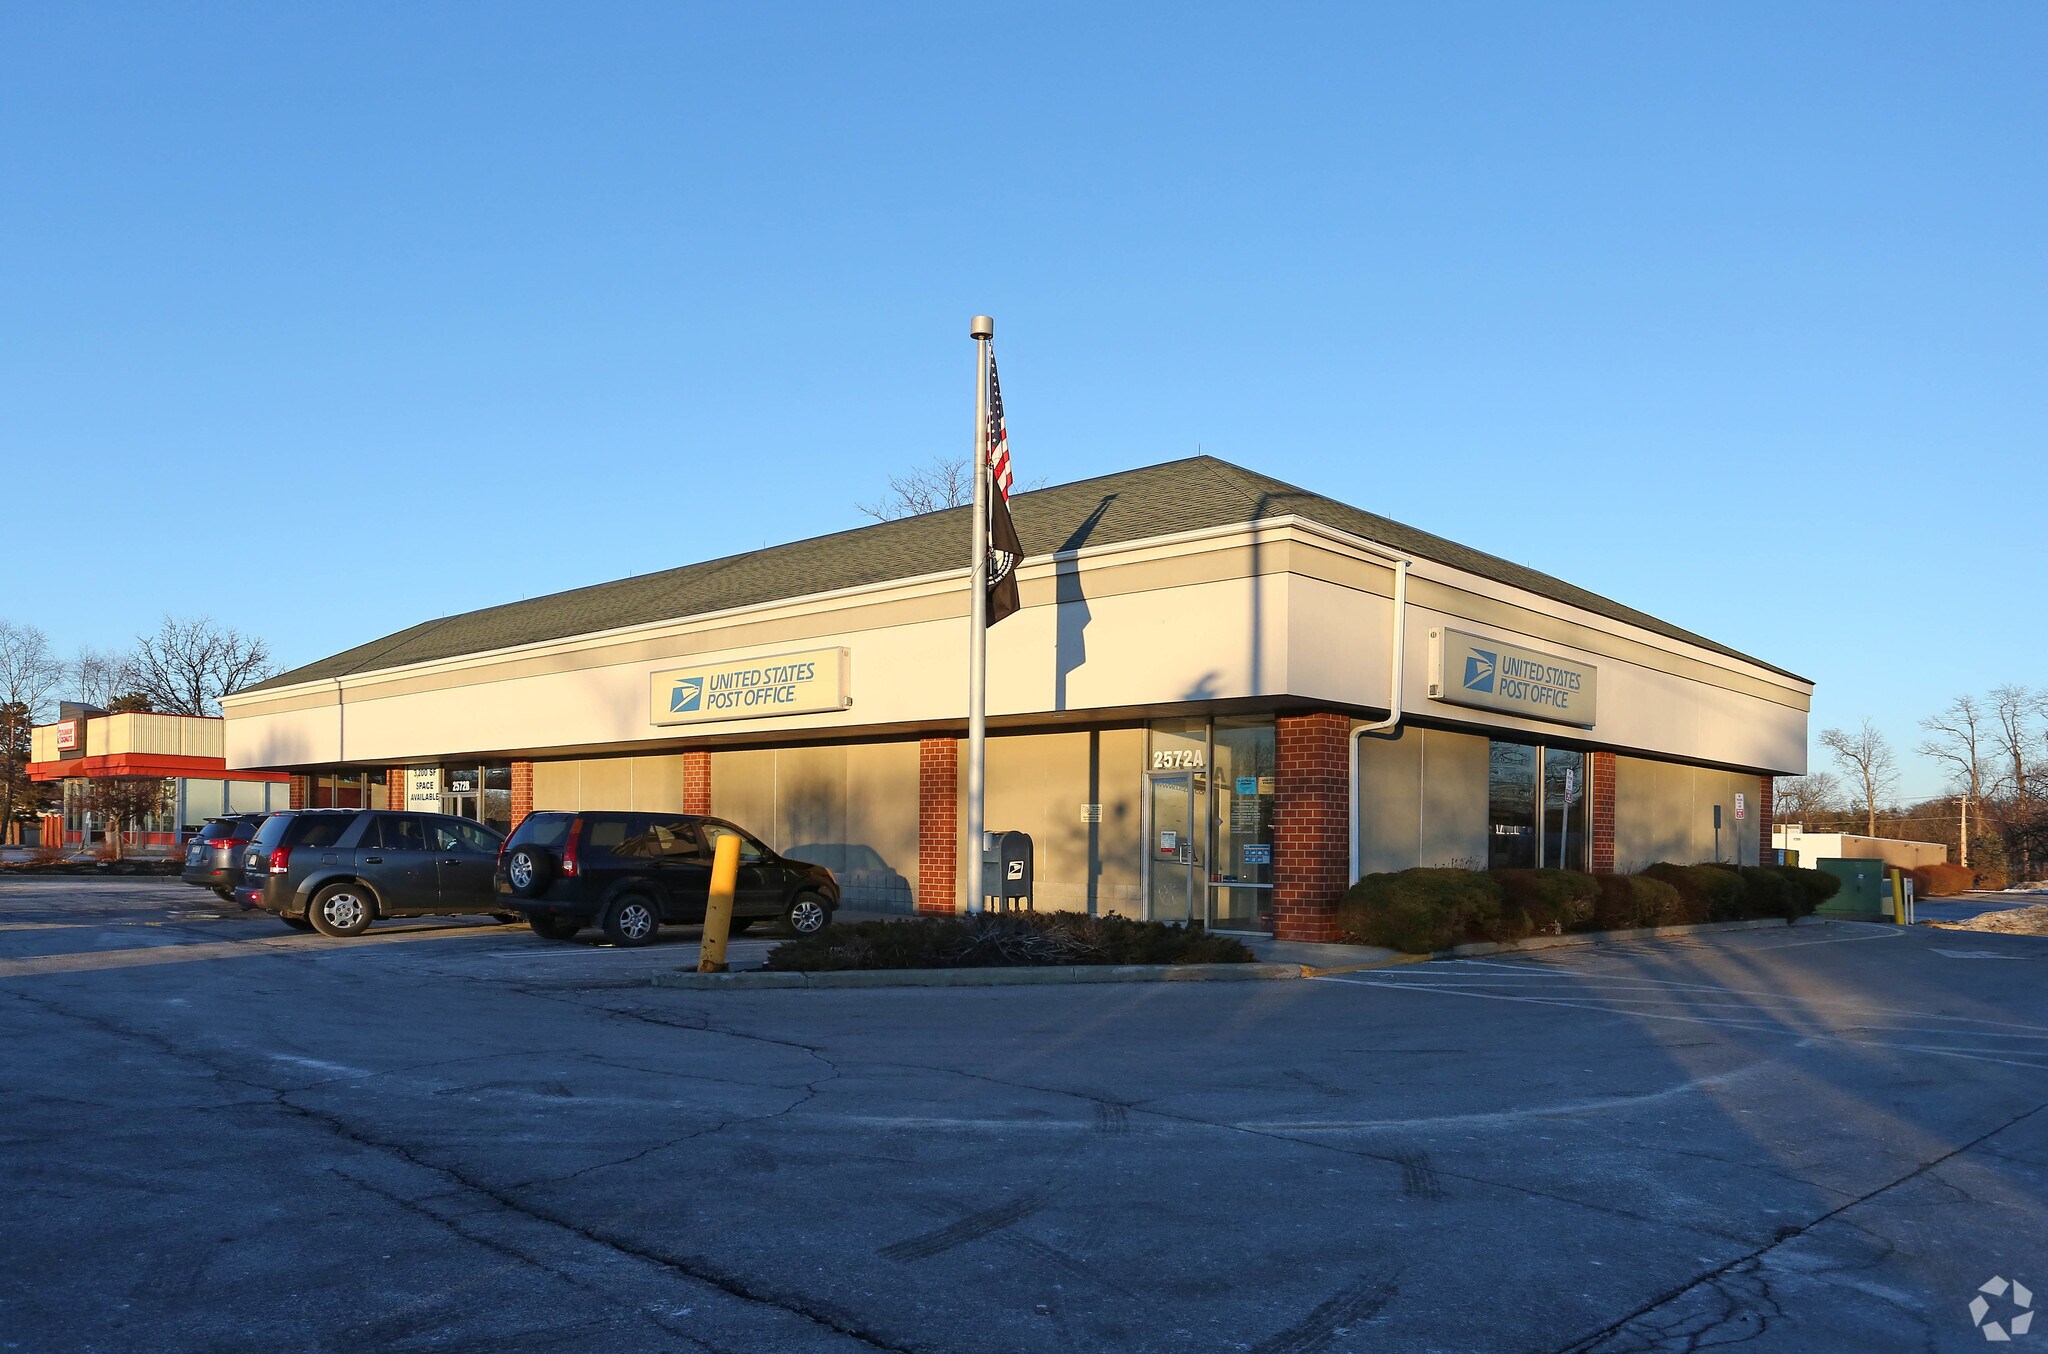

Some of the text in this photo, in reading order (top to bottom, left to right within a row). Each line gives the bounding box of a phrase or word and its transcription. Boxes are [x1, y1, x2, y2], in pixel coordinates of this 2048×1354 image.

[710, 662, 815, 690] UNITED STATES
[1502, 656, 1581, 690] UNITED STATES
[707, 685, 795, 709] POST OFFICE
[1499, 678, 1569, 709] POST OFFICE
[1153, 750, 1204, 768] 2572A
[411, 793, 439, 801] AVAILABLE
[416, 782, 433, 790] SPACE
